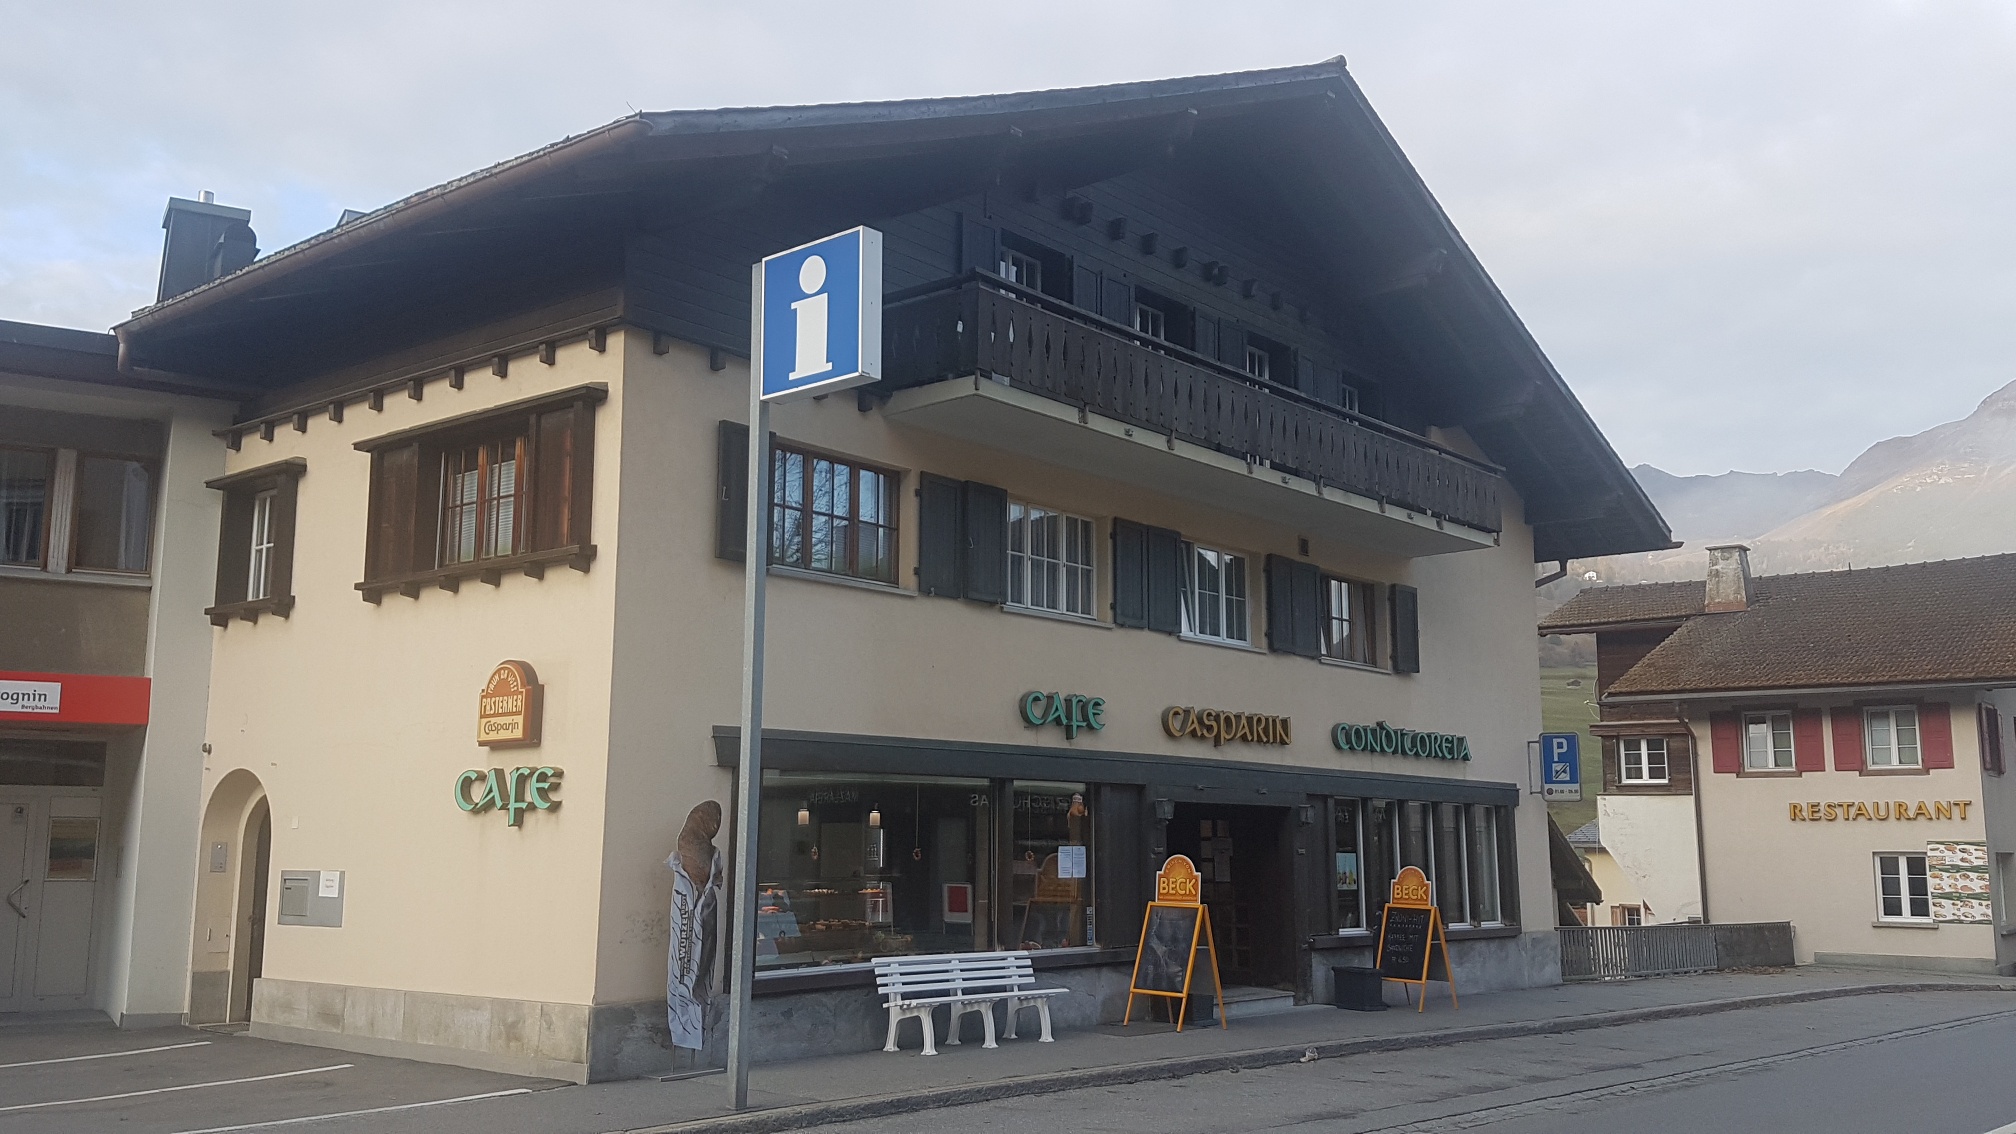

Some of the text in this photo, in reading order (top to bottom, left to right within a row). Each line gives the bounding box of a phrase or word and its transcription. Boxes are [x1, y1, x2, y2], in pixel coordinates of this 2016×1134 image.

[789, 255, 833, 380] i
[0, 689, 47, 705] ognin
[481, 695, 522, 715] PASTERNER
[483, 718, 519, 735] Casparin
[1019, 690, 1472, 761] CAFE CASPARIN CONDITOREIA
[1552, 738, 1568, 761] P
[455, 766, 563, 827] CAFE
[1789, 800, 1972, 821] RESTAURANT
[1160, 877, 1196, 895] BECK
[1394, 884, 1427, 900] BECK
